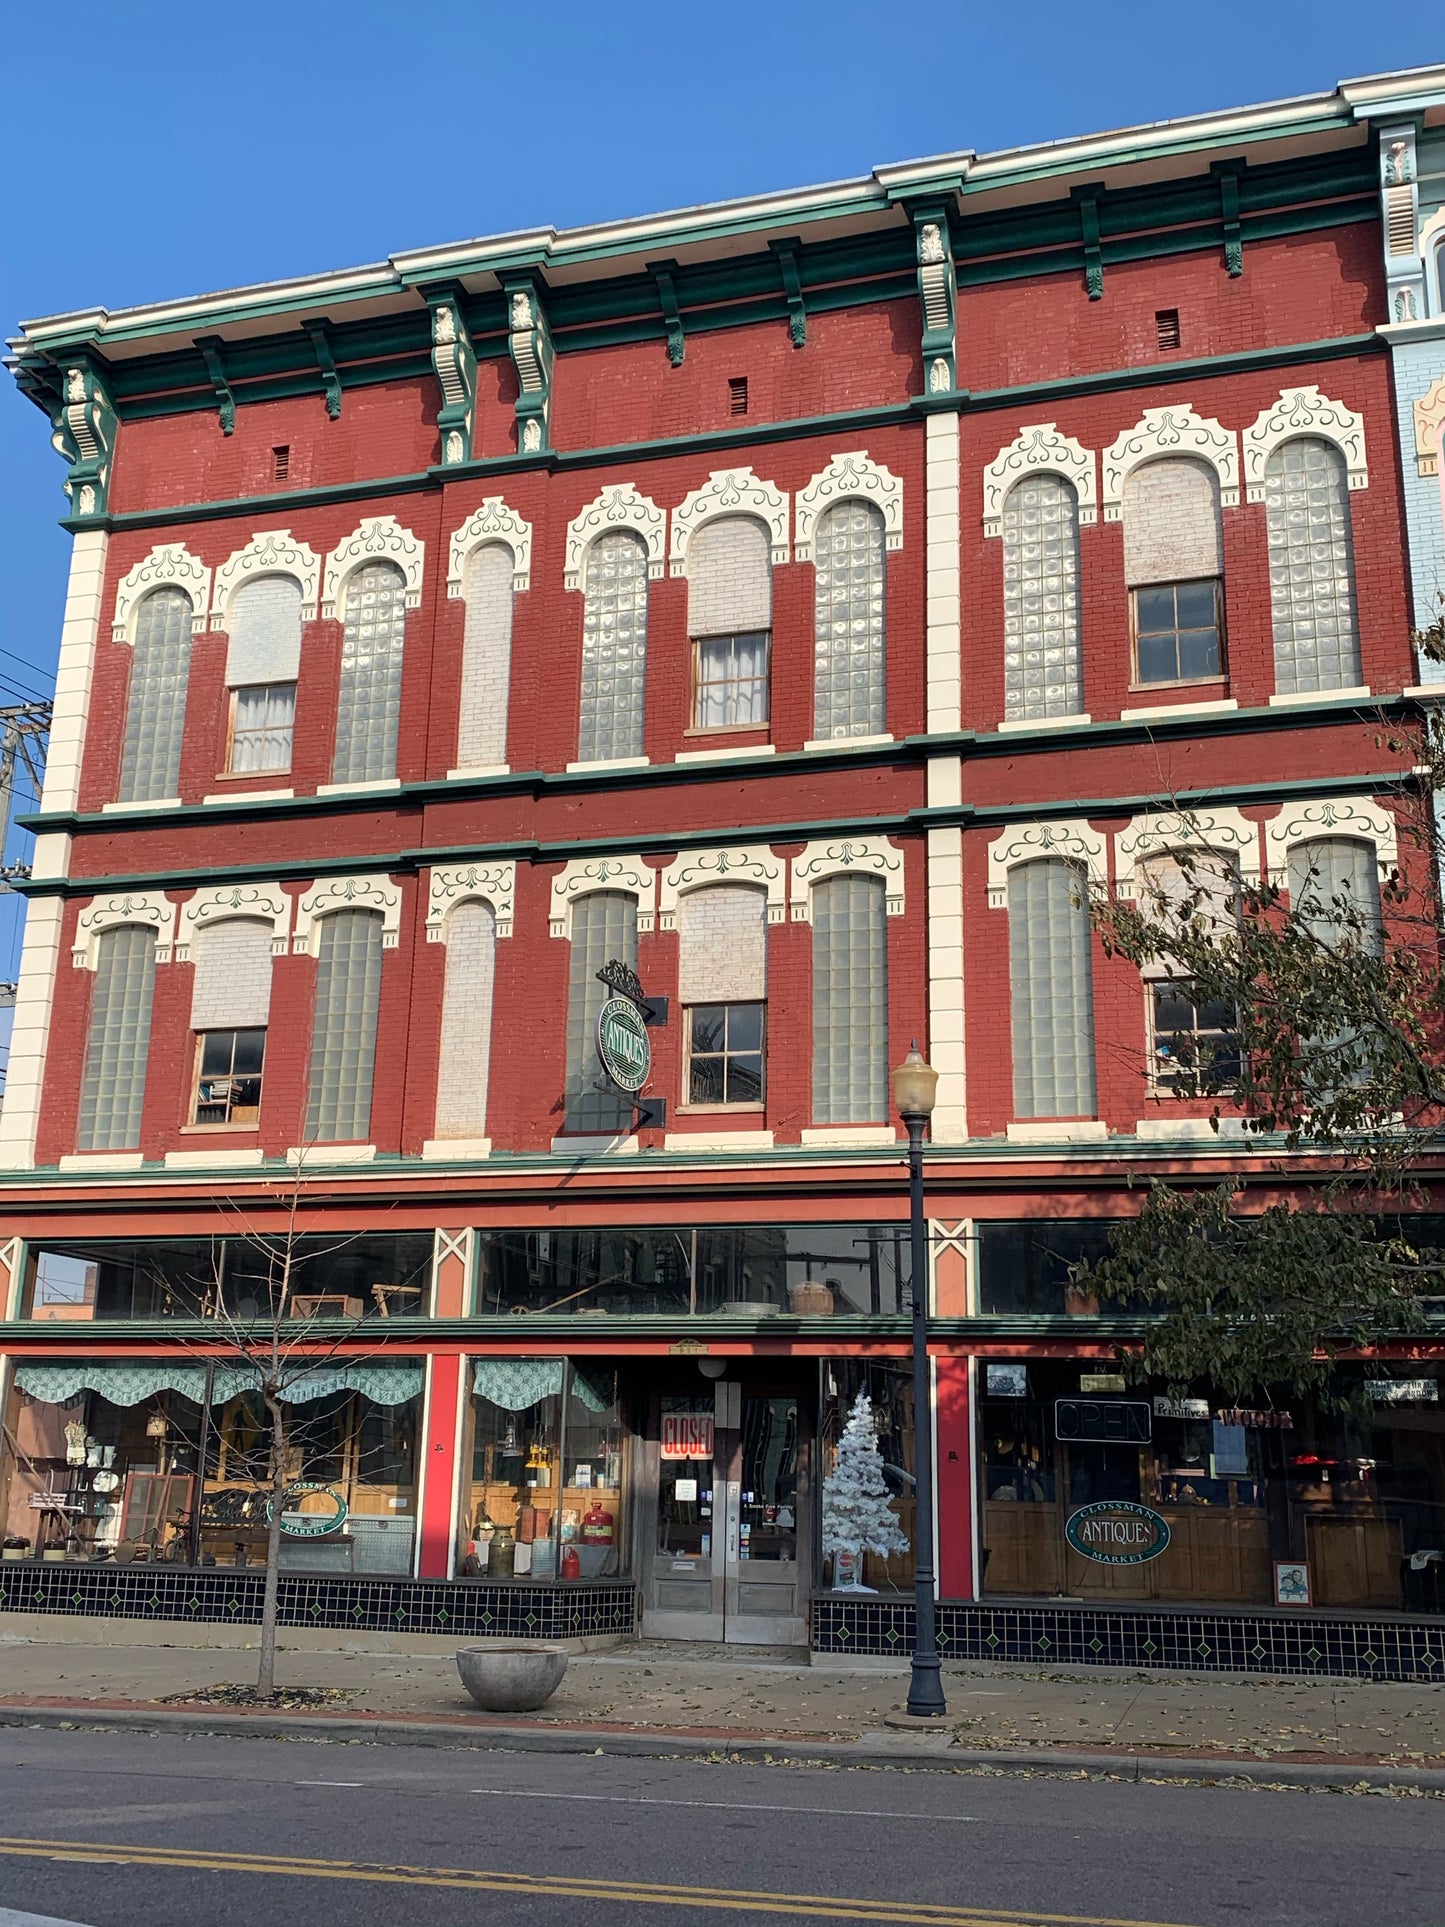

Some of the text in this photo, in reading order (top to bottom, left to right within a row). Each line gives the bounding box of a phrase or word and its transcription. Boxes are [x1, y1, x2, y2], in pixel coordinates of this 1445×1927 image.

[607, 1001, 645, 1035] CLOSSMAN
[607, 1019, 645, 1067] ANTIQUES
[612, 1066, 638, 1088] MARKET
[1158, 1403, 1206, 1417] Primitives
[1059, 1403, 1147, 1440] OPEN
[664, 1417, 714, 1454] CLOSED
[1080, 1503, 1154, 1520] CLOSSMAN
[284, 1525, 326, 1535] MARKET
[1092, 1551, 1143, 1563] MARKET
